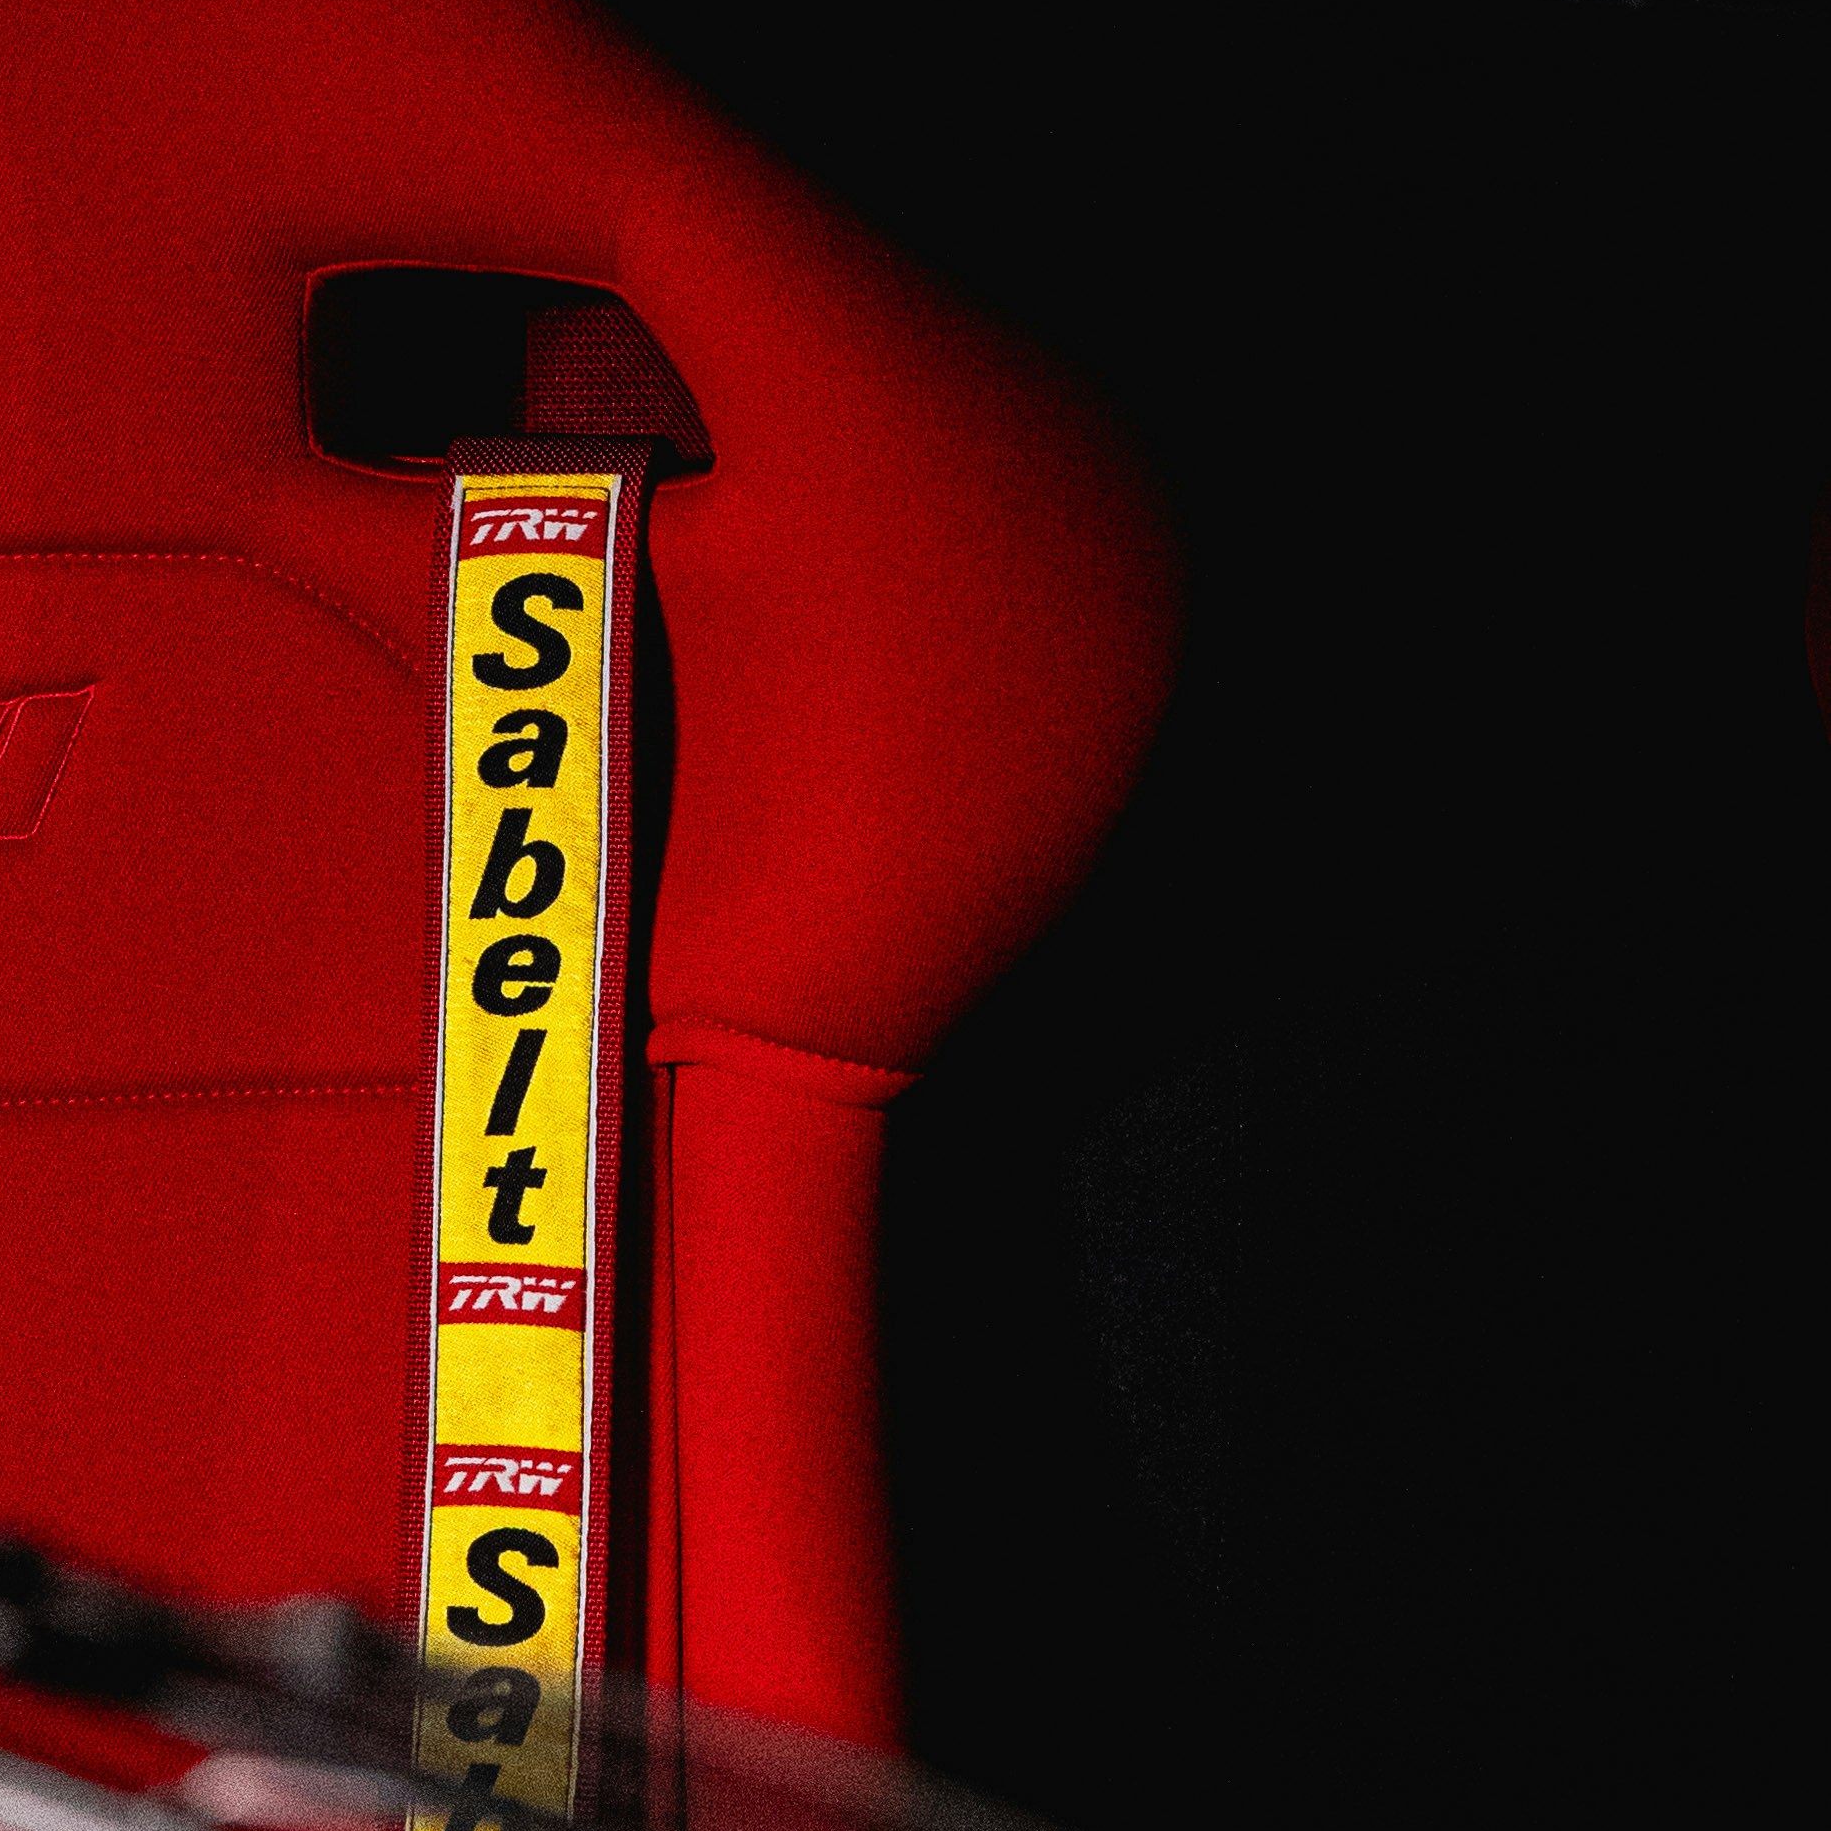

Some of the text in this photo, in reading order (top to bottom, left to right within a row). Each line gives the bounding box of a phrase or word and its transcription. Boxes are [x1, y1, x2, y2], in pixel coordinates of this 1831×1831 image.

[470, 507, 597, 544] TRW
[470, 573, 583, 1244] Sabelt
[447, 1274, 576, 1314] TRW
[443, 1456, 572, 1497] TRW
